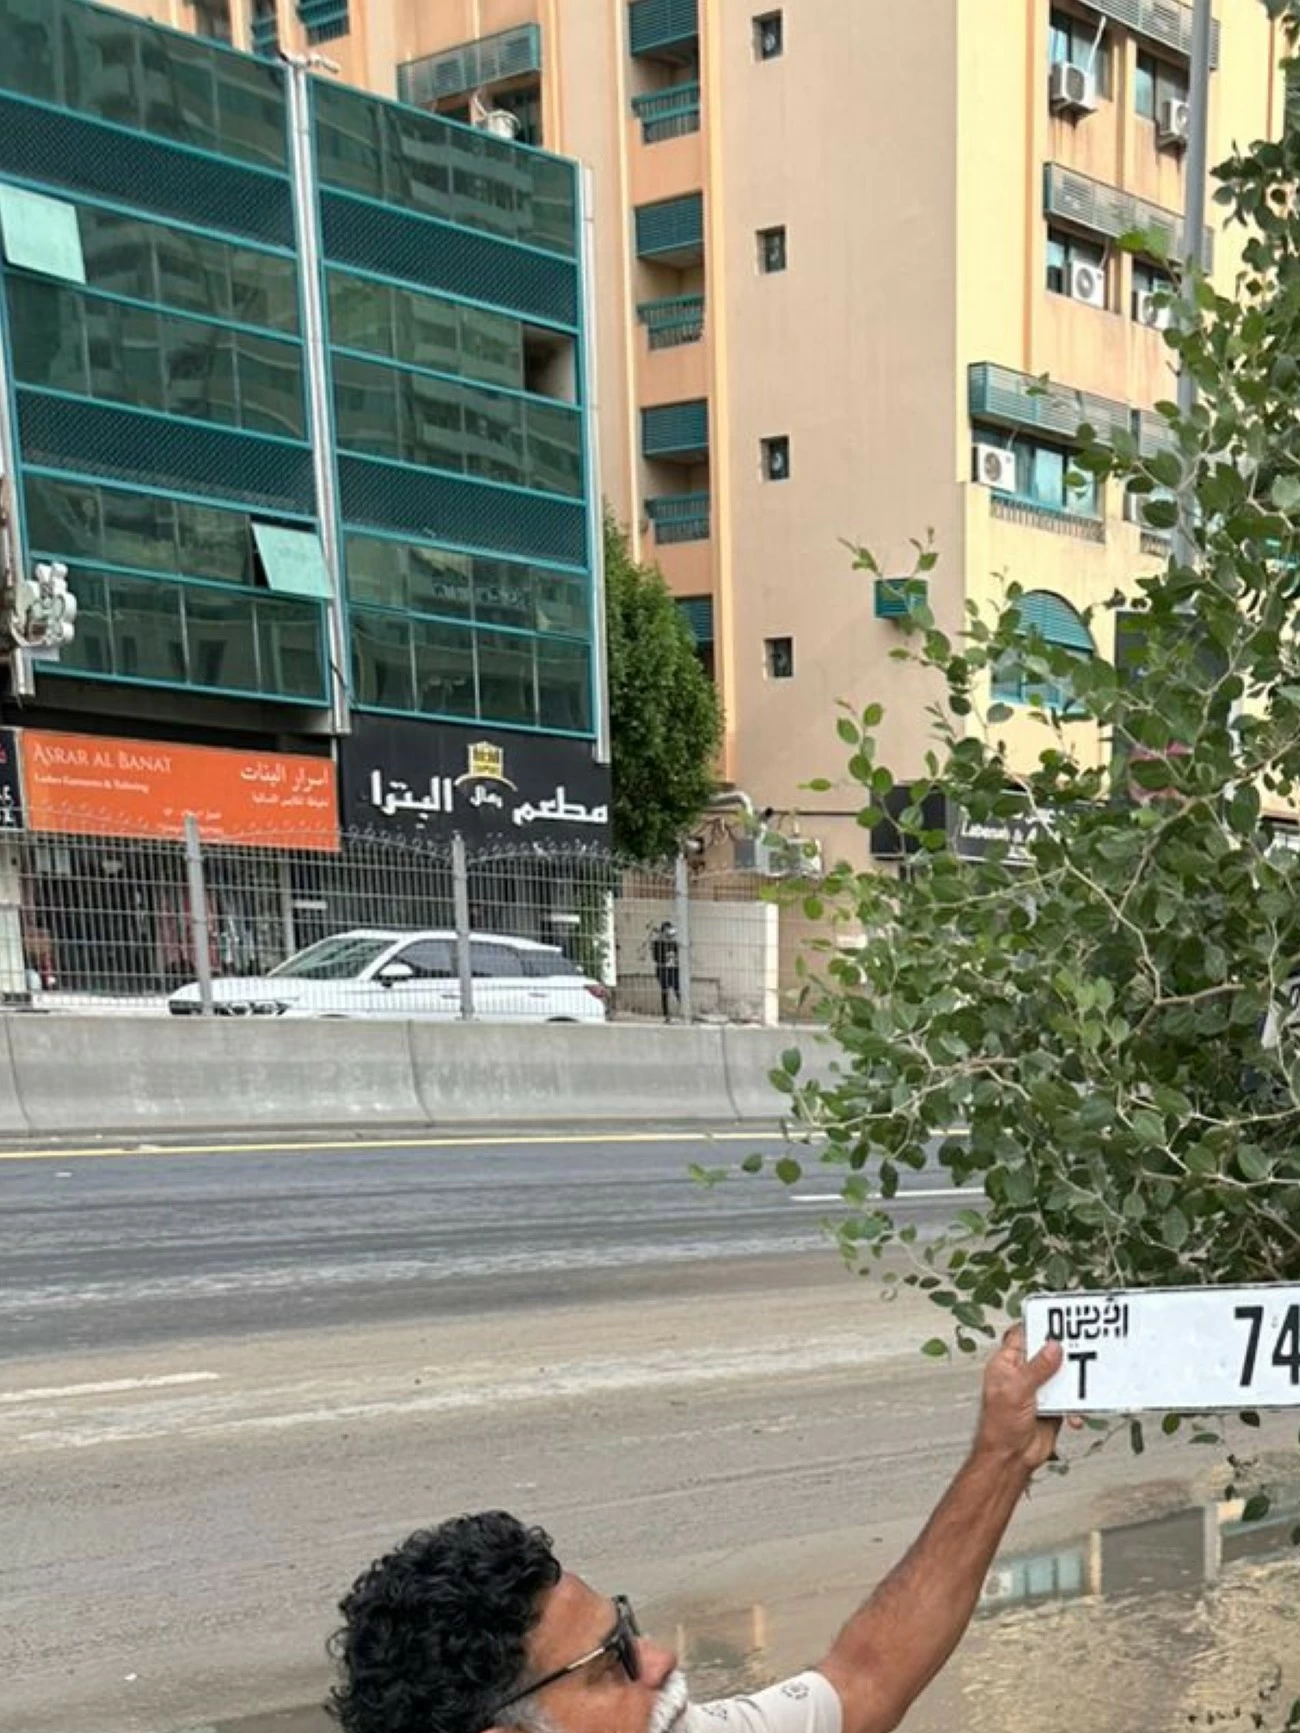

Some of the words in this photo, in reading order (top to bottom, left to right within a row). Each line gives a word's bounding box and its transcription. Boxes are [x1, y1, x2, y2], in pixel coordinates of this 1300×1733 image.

[32, 743, 89, 766] ASRAR
[92, 752, 114, 768] AL
[119, 751, 172, 772] BANAT
[371, 769, 453, 830] البترا
[512, 786, 609, 826] مطعم
[1067, 1351, 1098, 1400] T
